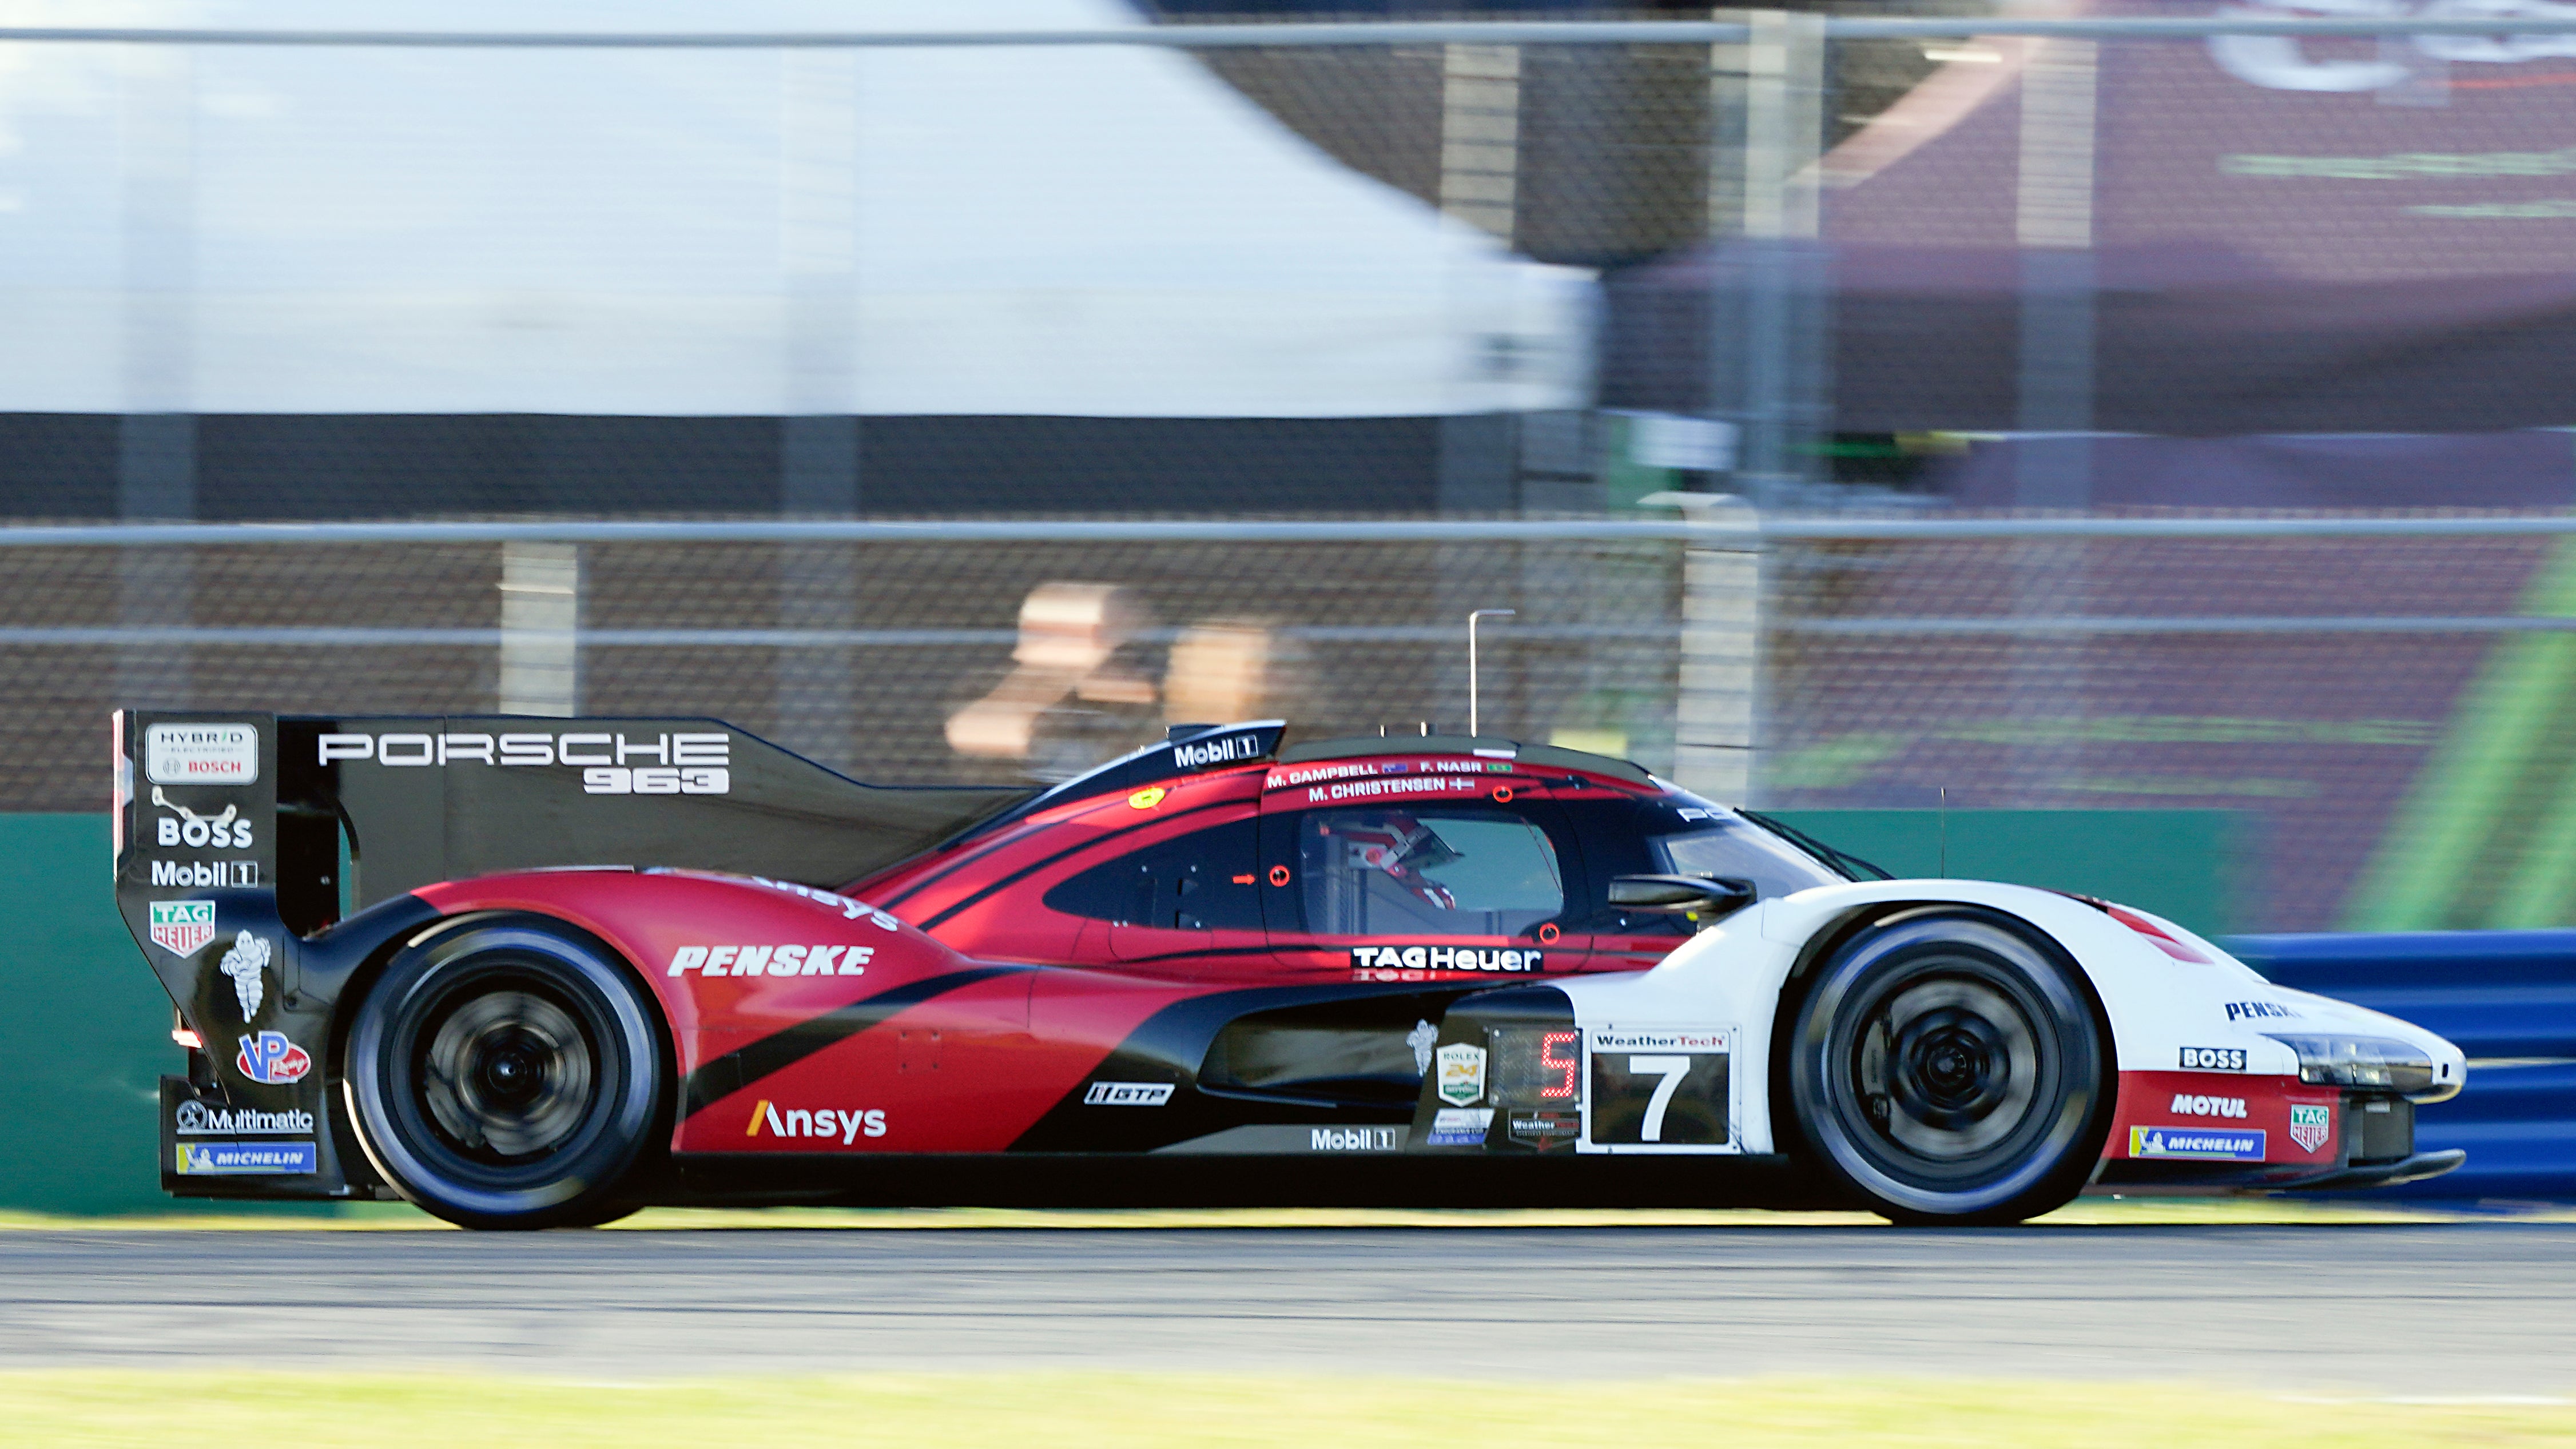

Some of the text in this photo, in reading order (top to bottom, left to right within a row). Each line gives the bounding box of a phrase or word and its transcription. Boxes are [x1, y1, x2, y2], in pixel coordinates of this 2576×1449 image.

[318, 733, 730, 767] PORSCHE
[1174, 738, 1234, 768] Mobil
[189, 761, 241, 773] BOSCH
[1267, 764, 1378, 788] M. CAMPBELL
[1420, 761, 1482, 772] F. NASR
[583, 767, 730, 795] 963
[1309, 777, 1446, 802] M. CHRISTENSEN
[158, 817, 253, 849] BOSS
[152, 860, 227, 886] Mobil
[155, 906, 209, 922] TAG
[751, 875, 899, 932] sys
[154, 926, 211, 951] HEUER
[667, 945, 874, 977] PENSKE
[1596, 1034, 1723, 1047] WeatherTech
[238, 1031, 288, 1081] VP
[1444, 1052, 1480, 1062] ROLEX
[1541, 1033, 1576, 1097] 5
[2184, 1048, 2243, 1070] BOSS
[1114, 1088, 1167, 1101] GTP
[1629, 1056, 1691, 1143] 7
[2170, 1093, 2248, 1119] MOTUL
[208, 1108, 313, 1129] Multimatic
[746, 1099, 887, 1145] Ansys
[2293, 1108, 2326, 1124] TAG
[1311, 1128, 1372, 1151] Mobil
[2168, 1136, 2255, 1152] MICHELIN
[2293, 1125, 2327, 1148] HEUER
[216, 1152, 304, 1165] MICHELIN
